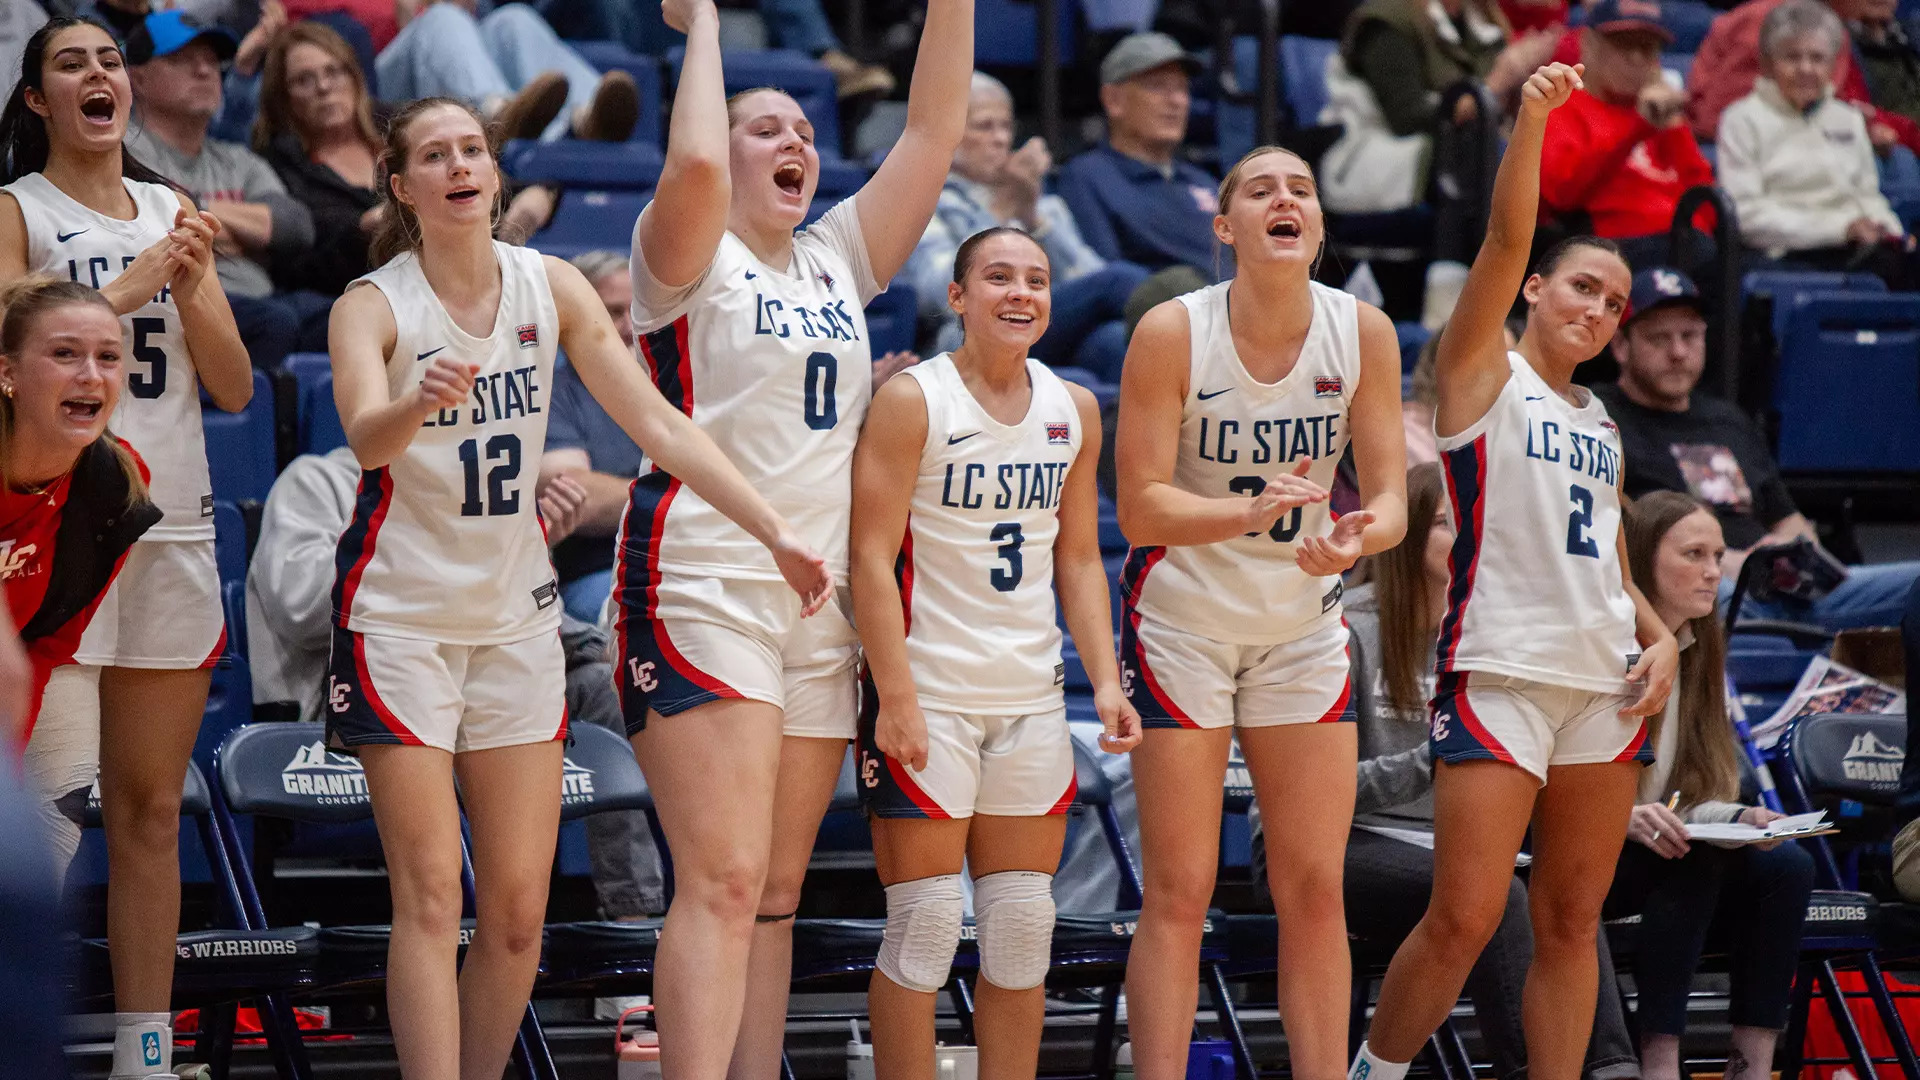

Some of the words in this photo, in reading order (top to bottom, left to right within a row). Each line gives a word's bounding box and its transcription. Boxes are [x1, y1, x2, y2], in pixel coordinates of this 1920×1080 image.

[755, 293, 790, 338] LC
[472, 365, 541, 425] STATE
[804, 352, 838, 430] 0
[1199, 417, 1239, 464] LC
[1252, 413, 1340, 464] STATE
[1526, 418, 1560, 463] LC
[458, 433, 521, 516] 12
[941, 463, 985, 509] LC
[1566, 483, 1600, 559] 2
[989, 522, 1025, 592] 3
[329, 674, 351, 713] LC
[628, 656, 658, 693] LC
[1121, 660, 1135, 698] LC
[1432, 710, 1451, 742] LC
[282, 773, 370, 795] GRANIT
[861, 750, 879, 788] LC
[316, 795, 371, 805] CONCEPT
[1804, 906, 1867, 921] RRIORS
[192, 939, 298, 958] WARRIORS
